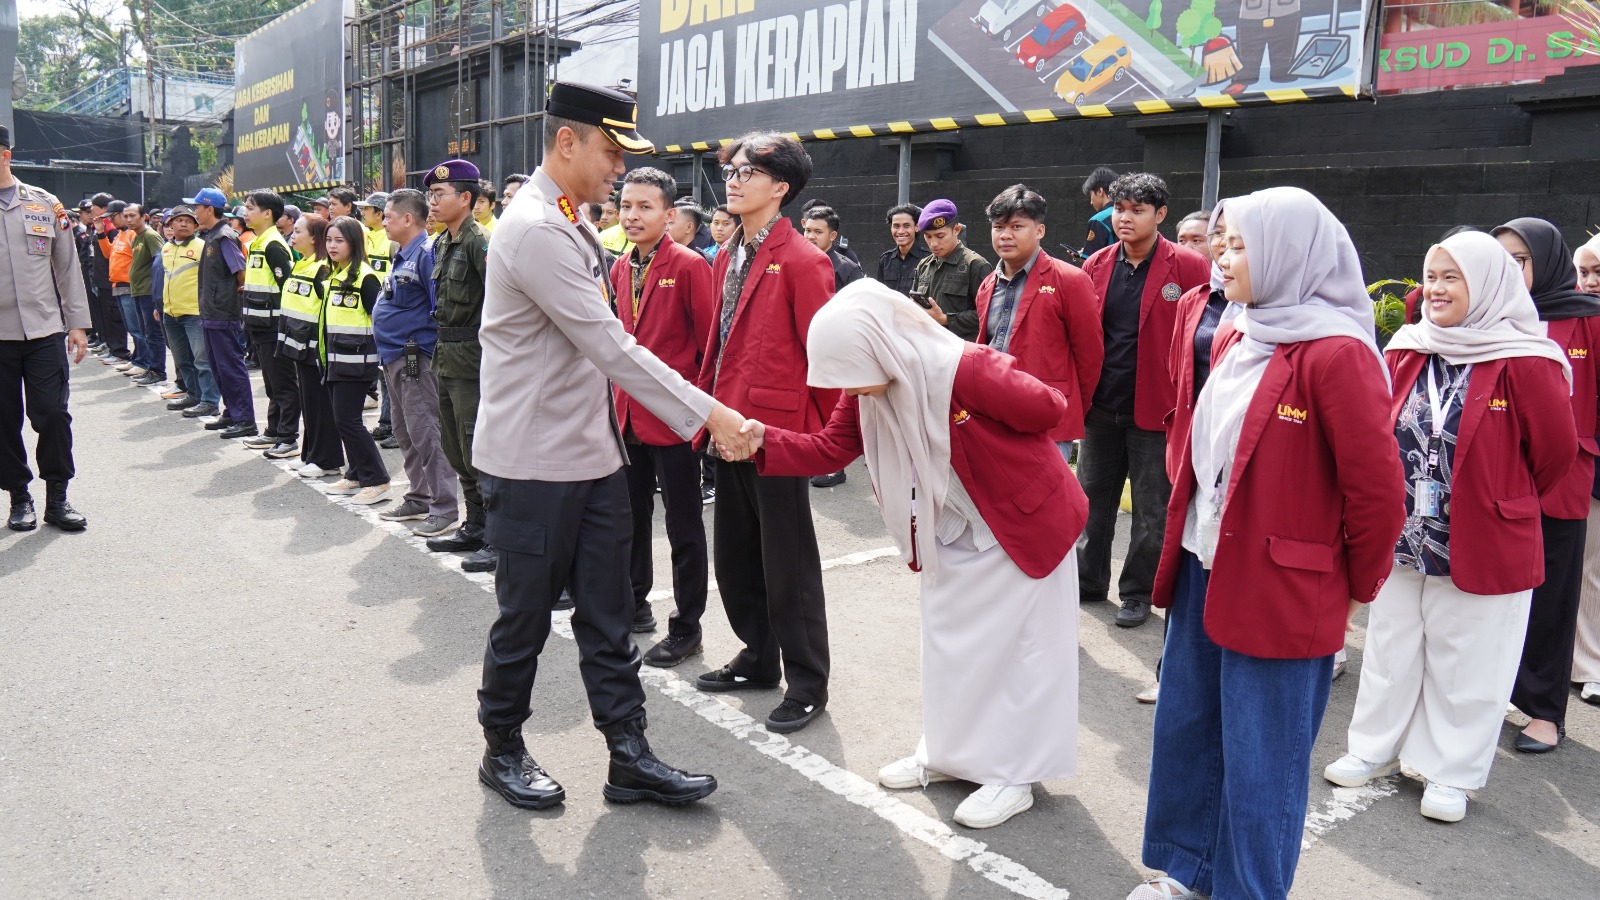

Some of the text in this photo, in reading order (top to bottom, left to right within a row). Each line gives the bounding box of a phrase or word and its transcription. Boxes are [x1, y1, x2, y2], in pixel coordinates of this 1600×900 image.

[656, 0, 918, 117] JAGA KERAPIAN
[1487, 37, 1536, 65] Dr.
[235, 68, 294, 110] JAGA KEBERSIHAN
[254, 104, 269, 126] DAN
[236, 122, 290, 154] JAGA KERAPIAN
[25, 214, 51, 223] POLRI
[1568, 348, 1588, 356] UMM
[1277, 403, 1307, 421] UMM
